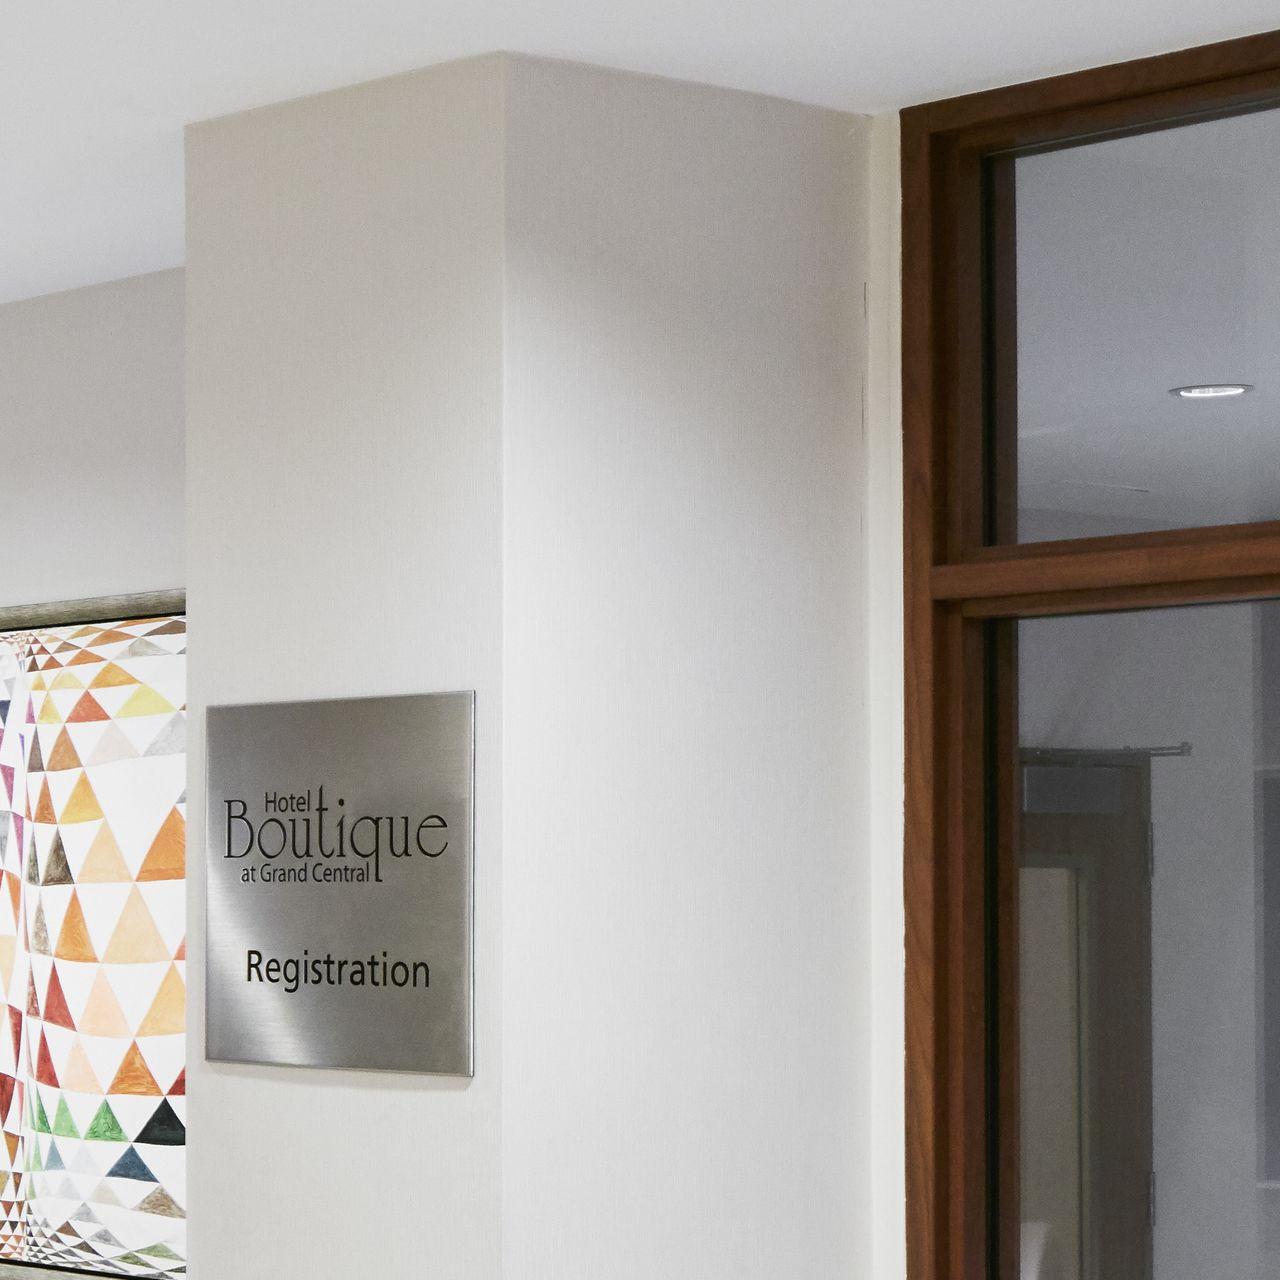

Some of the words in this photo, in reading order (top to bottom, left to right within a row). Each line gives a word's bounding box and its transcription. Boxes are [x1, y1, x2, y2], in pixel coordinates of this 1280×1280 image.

[265, 790, 310, 813] Hotel
[223, 785, 448, 882] Boutique
[241, 866, 256, 882] at
[259, 863, 307, 882] Grand
[312, 862, 369, 882] Central
[246, 949, 429, 992] Registration
